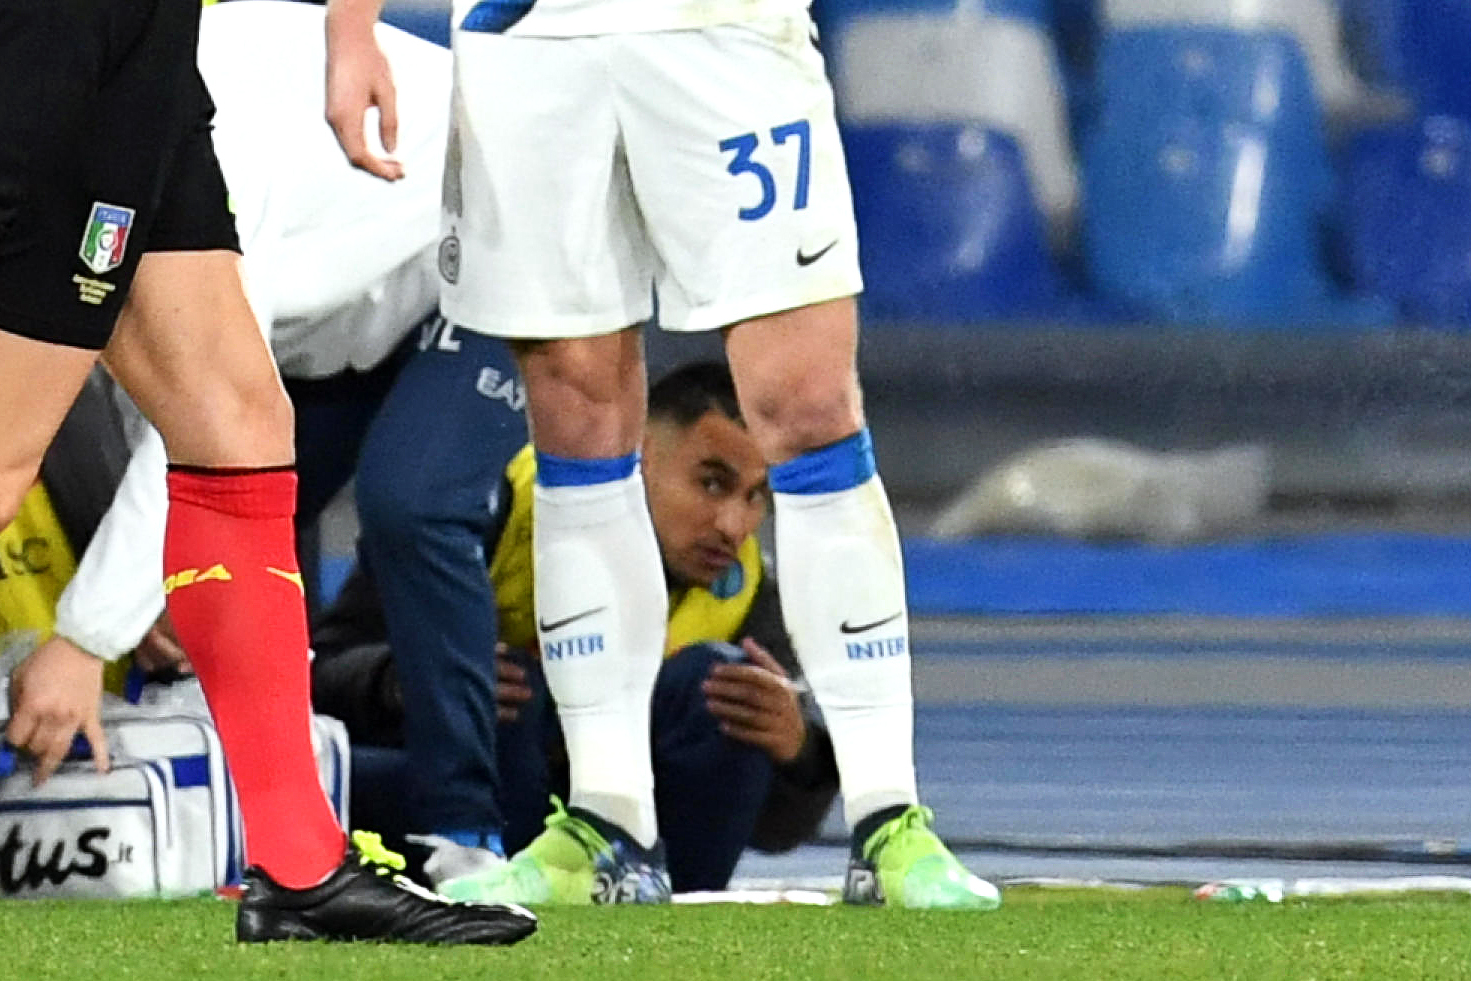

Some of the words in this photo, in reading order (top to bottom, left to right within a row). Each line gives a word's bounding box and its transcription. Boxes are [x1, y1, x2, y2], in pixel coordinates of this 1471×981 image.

[718, 119, 811, 221] 37
[543, 633, 605, 661] NTER
[845, 636, 906, 660] INTER
